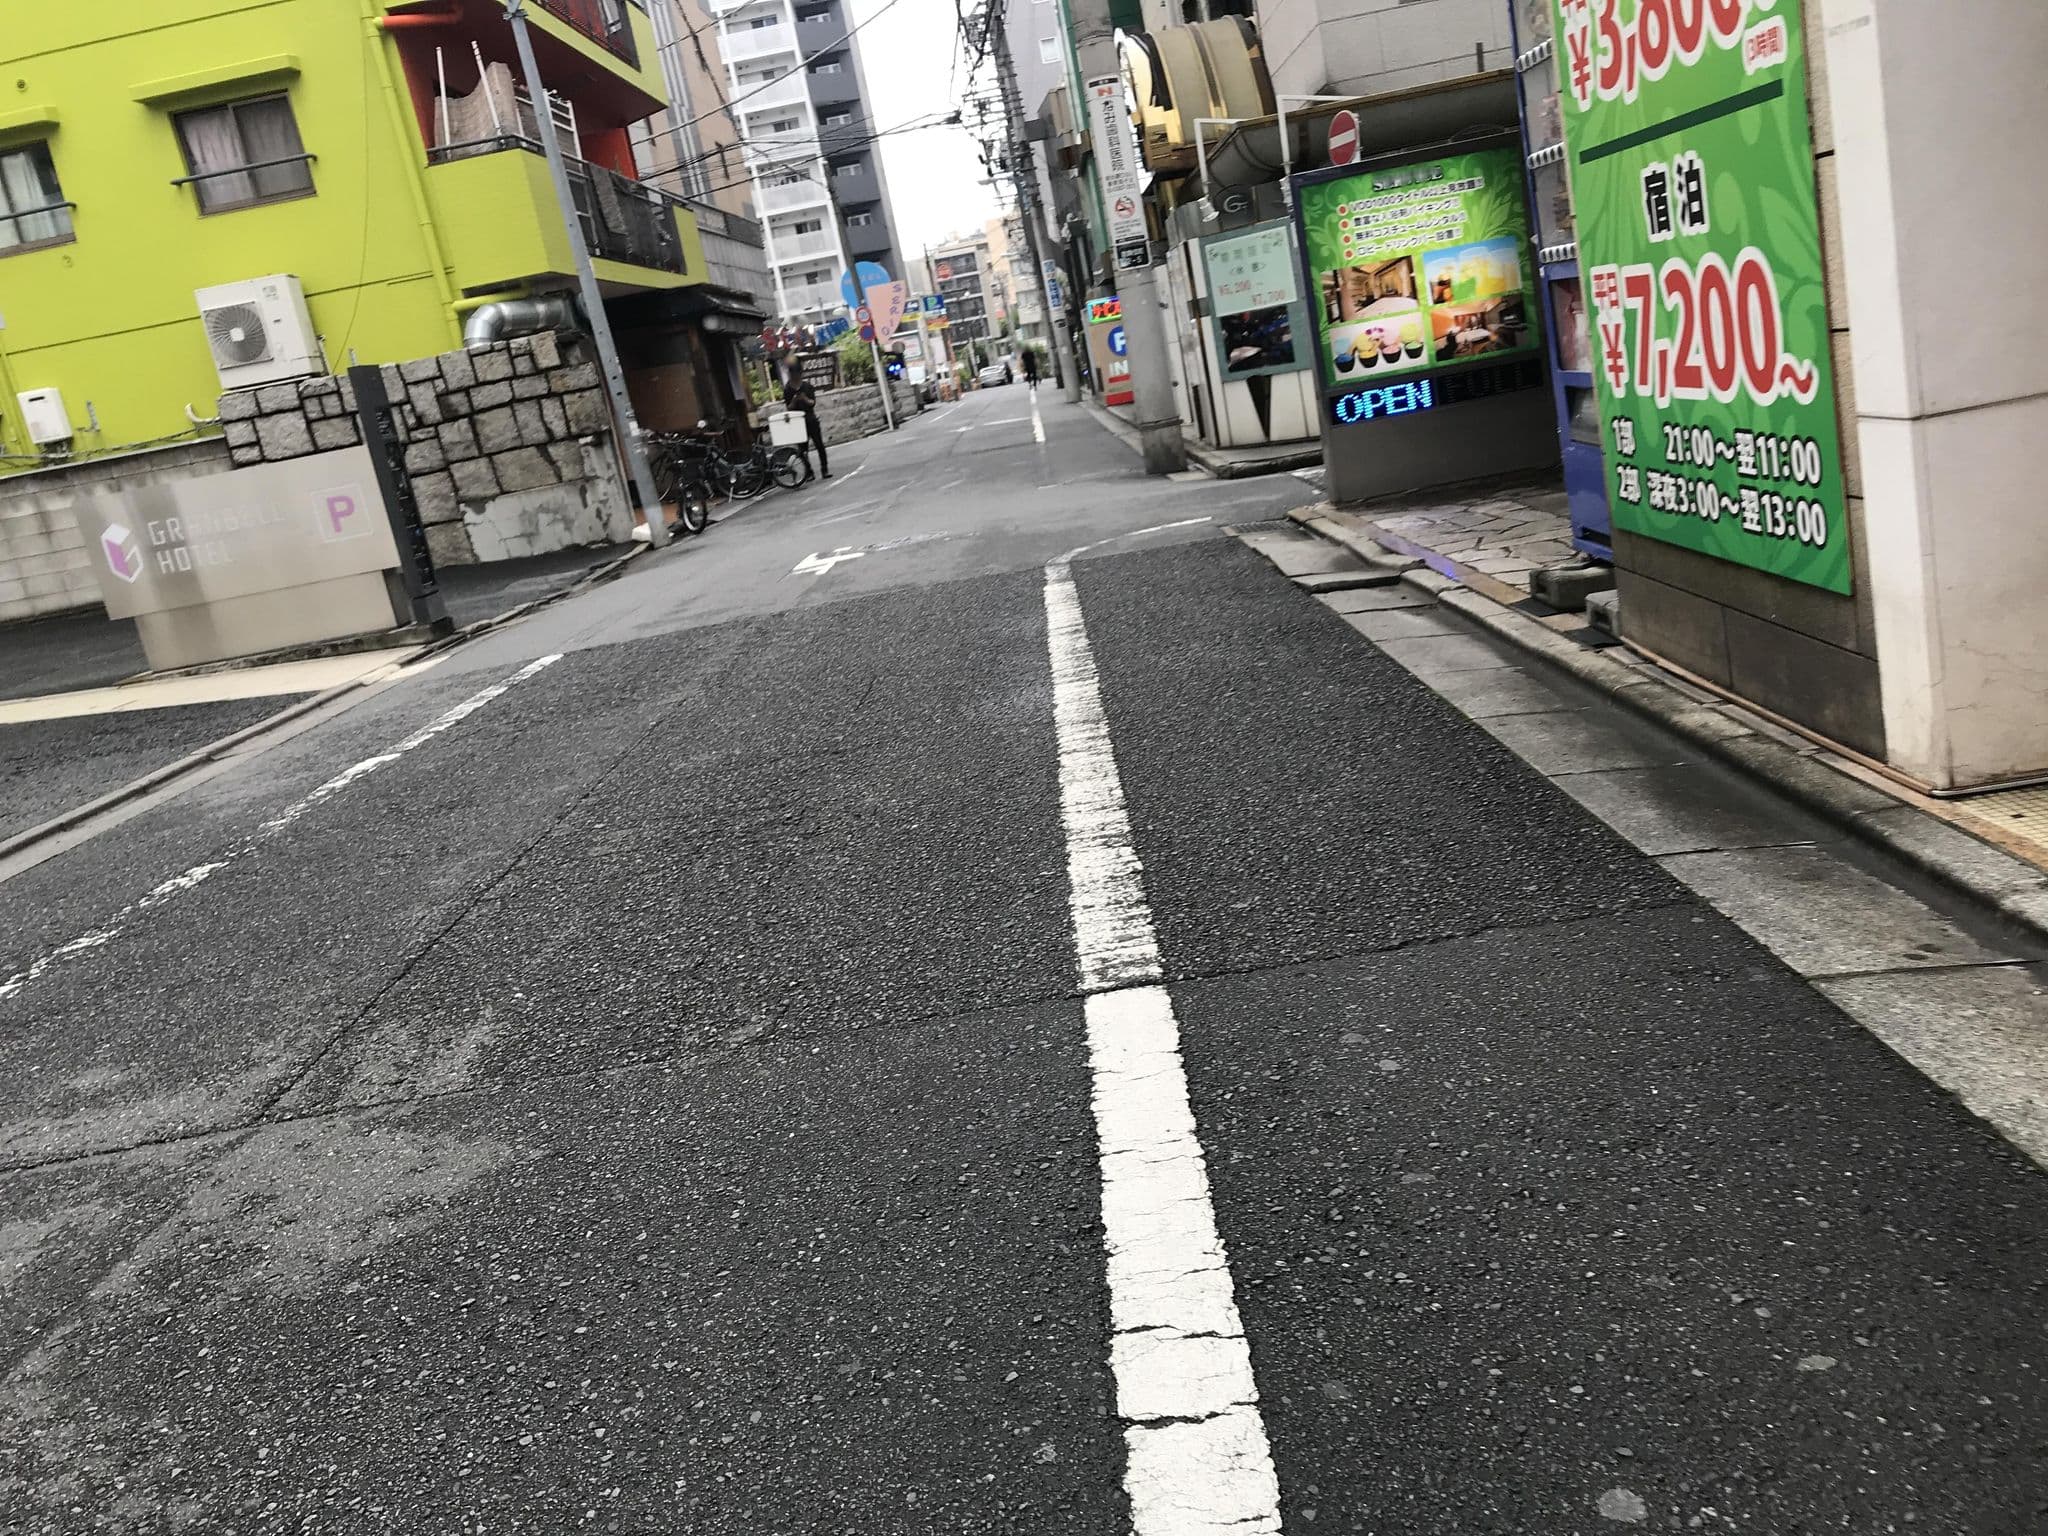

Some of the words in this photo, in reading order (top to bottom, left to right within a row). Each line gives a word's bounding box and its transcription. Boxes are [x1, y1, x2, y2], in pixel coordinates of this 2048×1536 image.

[1568, 0, 1741, 101] ¥3,8
[1644, 159, 1706, 235] 宿泊
[1336, 379, 1432, 423] OPEN
[327, 495, 355, 533] P
[156, 540, 234, 574] HOTEL
